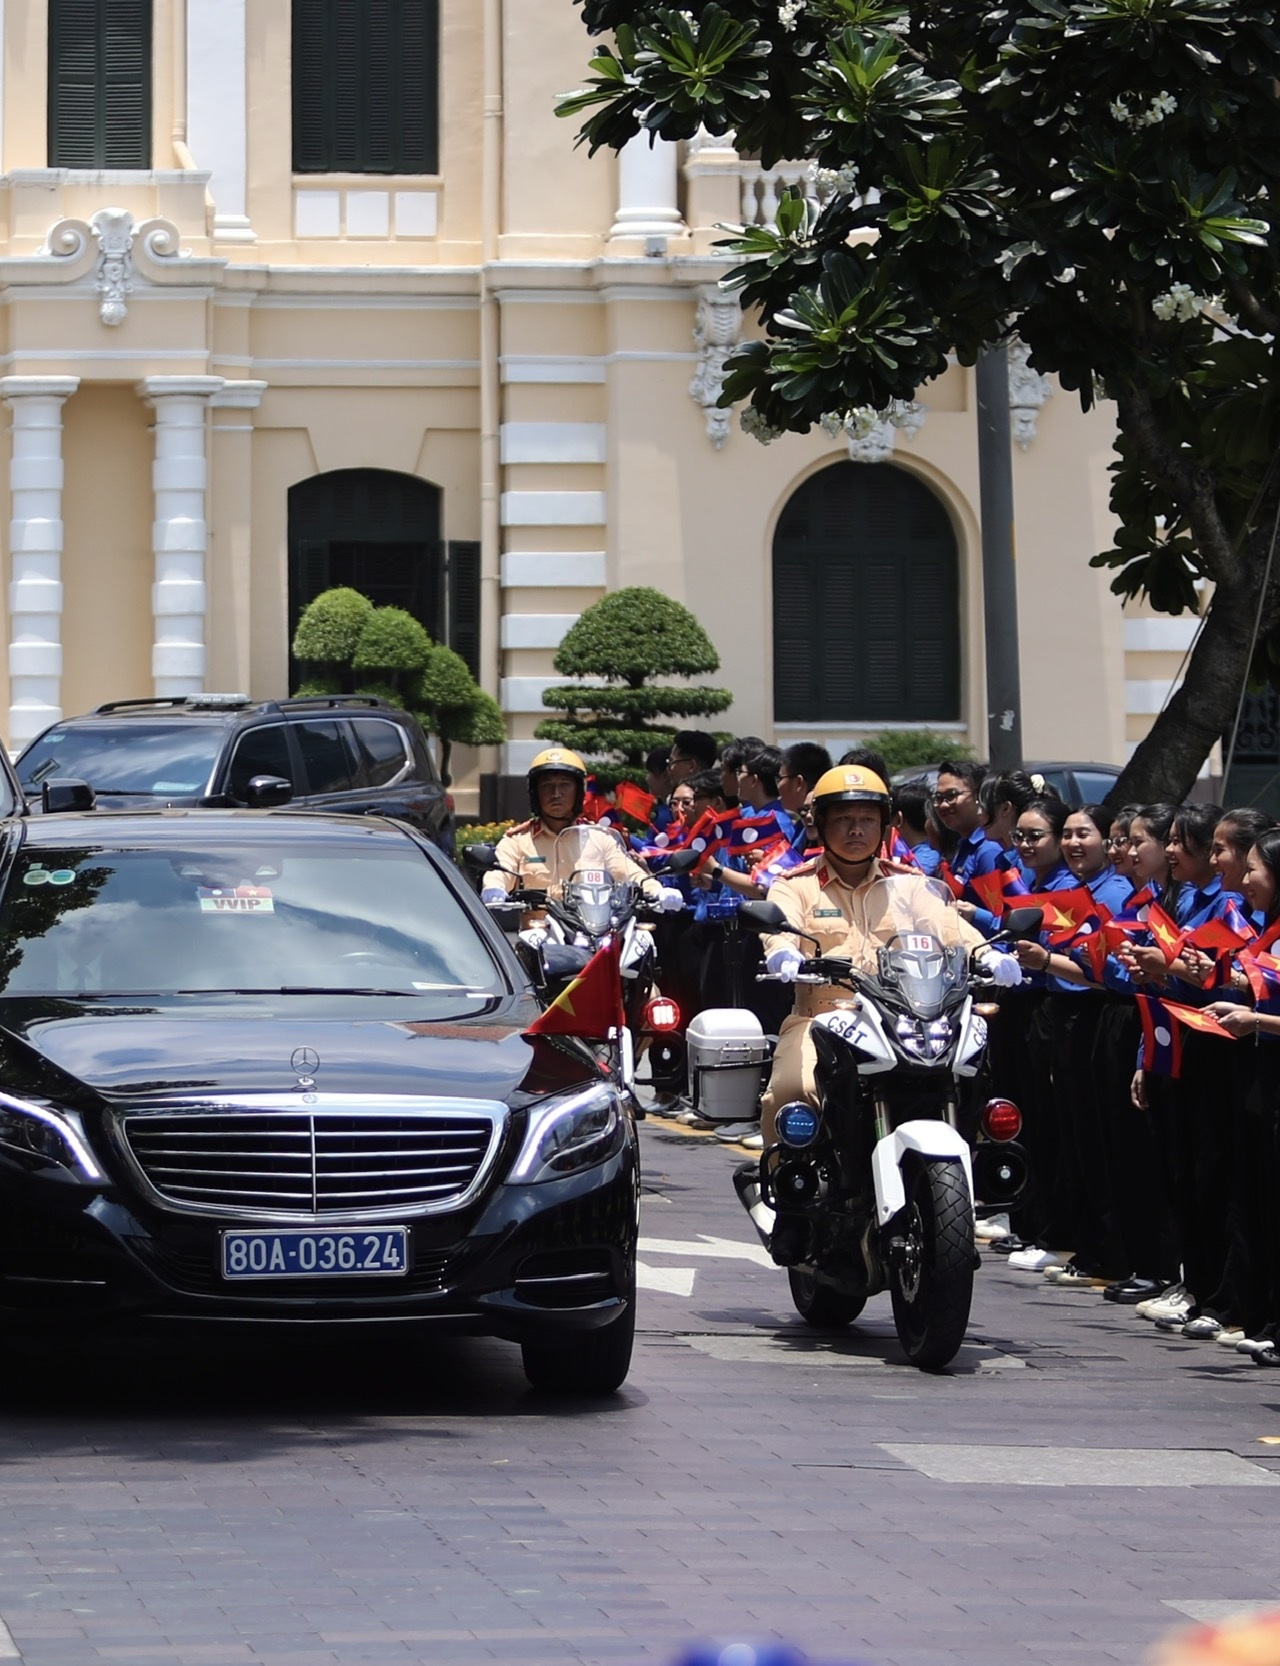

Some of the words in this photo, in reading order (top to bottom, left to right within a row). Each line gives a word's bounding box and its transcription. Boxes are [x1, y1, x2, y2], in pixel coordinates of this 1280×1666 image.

[587, 872, 602, 883] 08
[213, 899, 261, 910] VVIP
[912, 936, 930, 950] 16
[827, 1015, 869, 1045] CSGT
[229, 1234, 401, 1272] 80A-036.24
